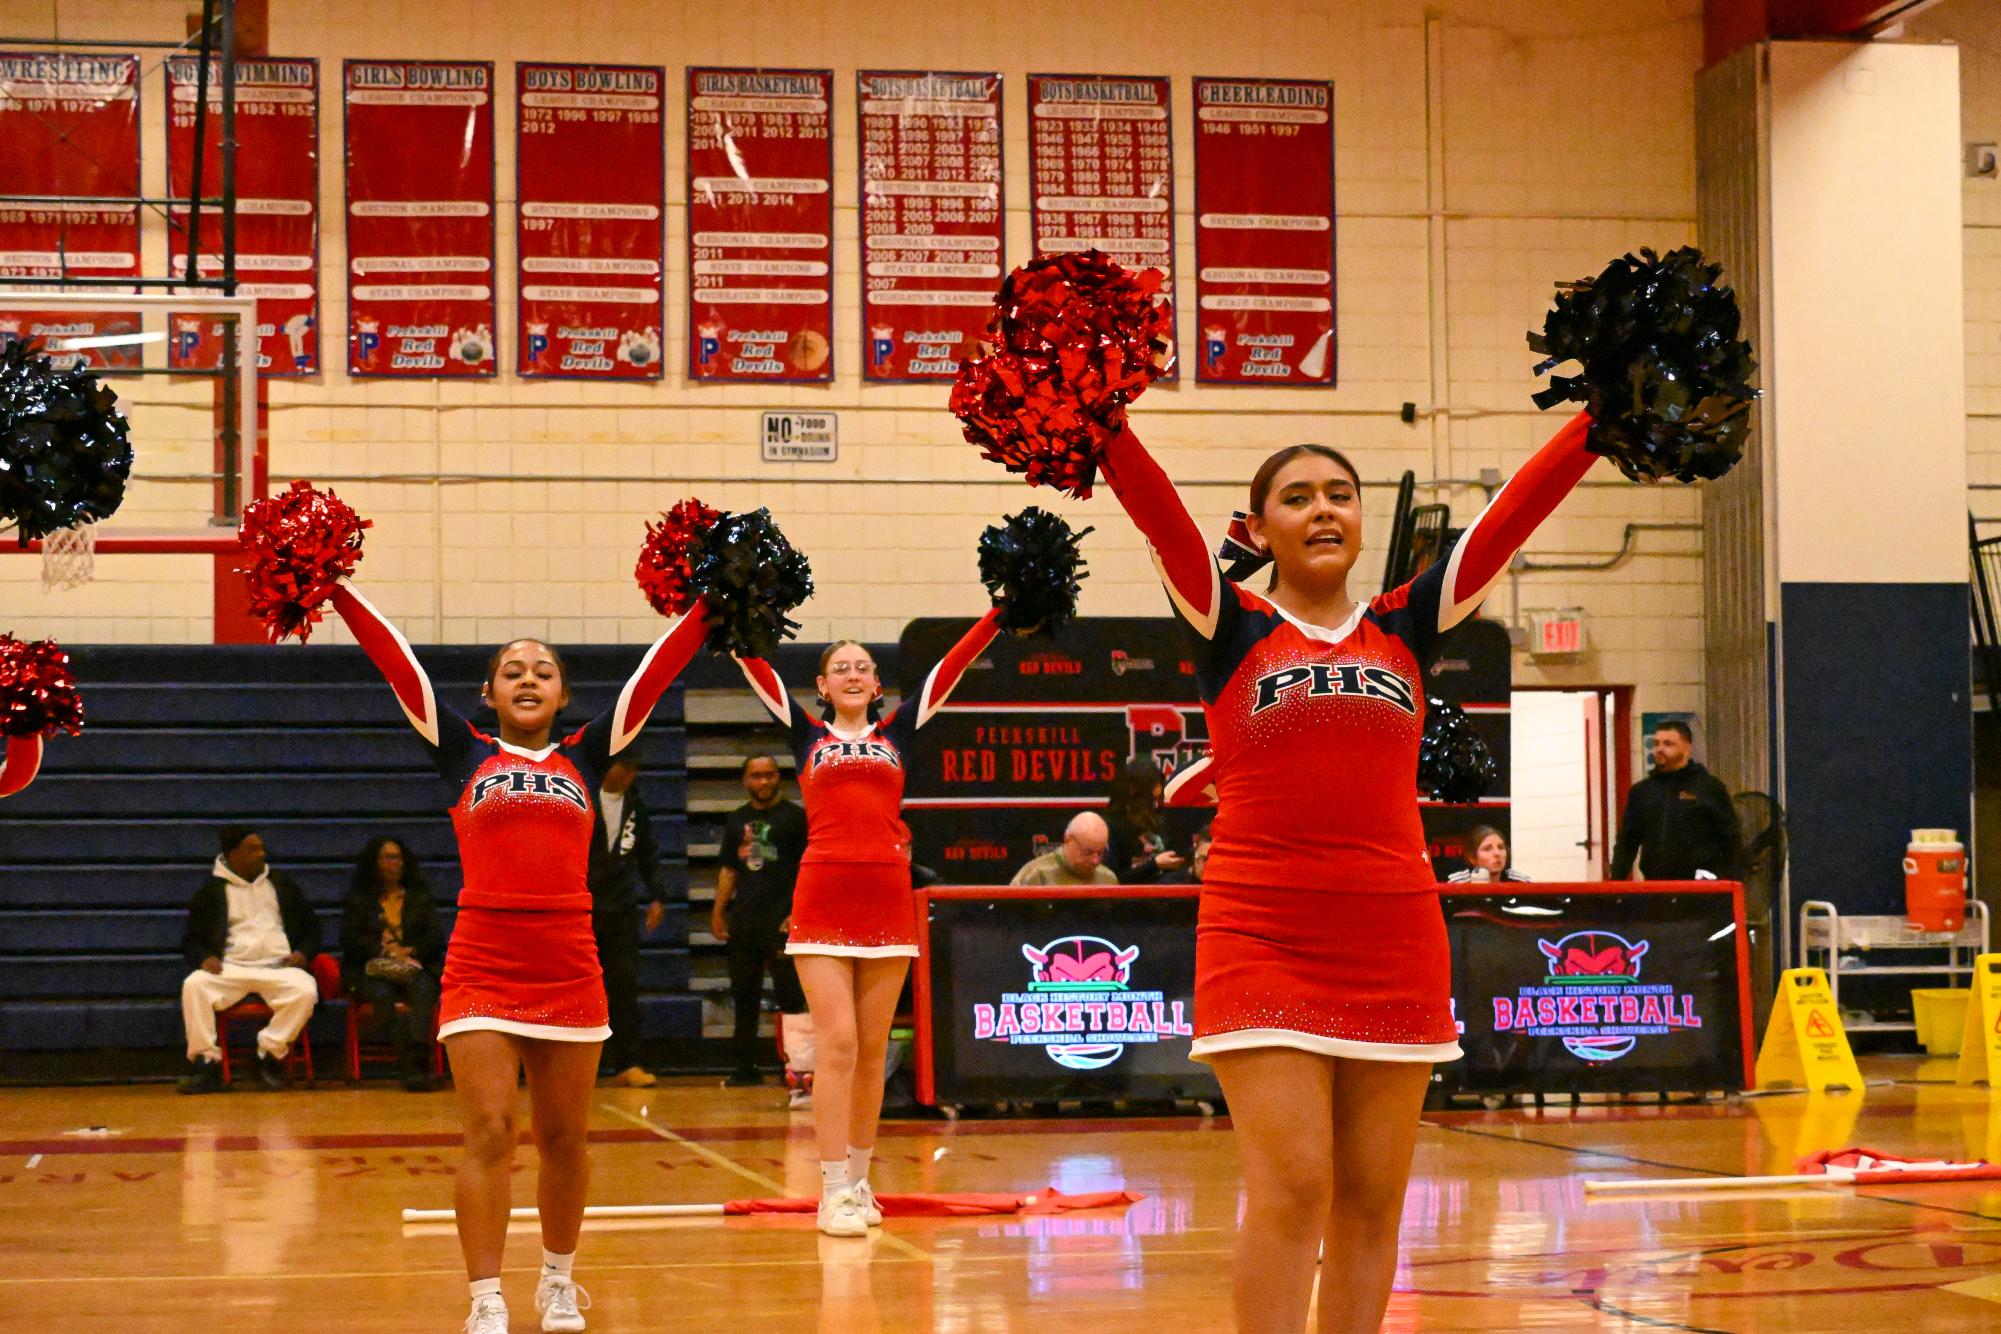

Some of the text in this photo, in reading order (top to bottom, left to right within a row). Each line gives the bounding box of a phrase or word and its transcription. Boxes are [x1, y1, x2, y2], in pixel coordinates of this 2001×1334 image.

[2, 60, 127, 82] WRESTLING
[352, 66, 487, 88] GIRLS BOWLING
[526, 71, 657, 92] BOYS BOWLING
[697, 75, 824, 98] GIRLS BASKETBALL
[1041, 82, 1158, 103] BOYS BASKETBALL
[1199, 84, 1328, 107] CHEERLEADING
[768, 416, 792, 443] NO
[1544, 621, 1580, 651] EXIT
[1251, 663, 1416, 717] PHS
[975, 727, 1081, 745] PEEKSKILL
[812, 742, 899, 769] PHS
[942, 749, 996, 782] RED
[1011, 748, 1117, 783] DEVILS
[471, 770, 587, 811] PHS
[974, 1001, 1193, 1040] BASKETBALL
[1492, 994, 1702, 1031] BASKETBALL
